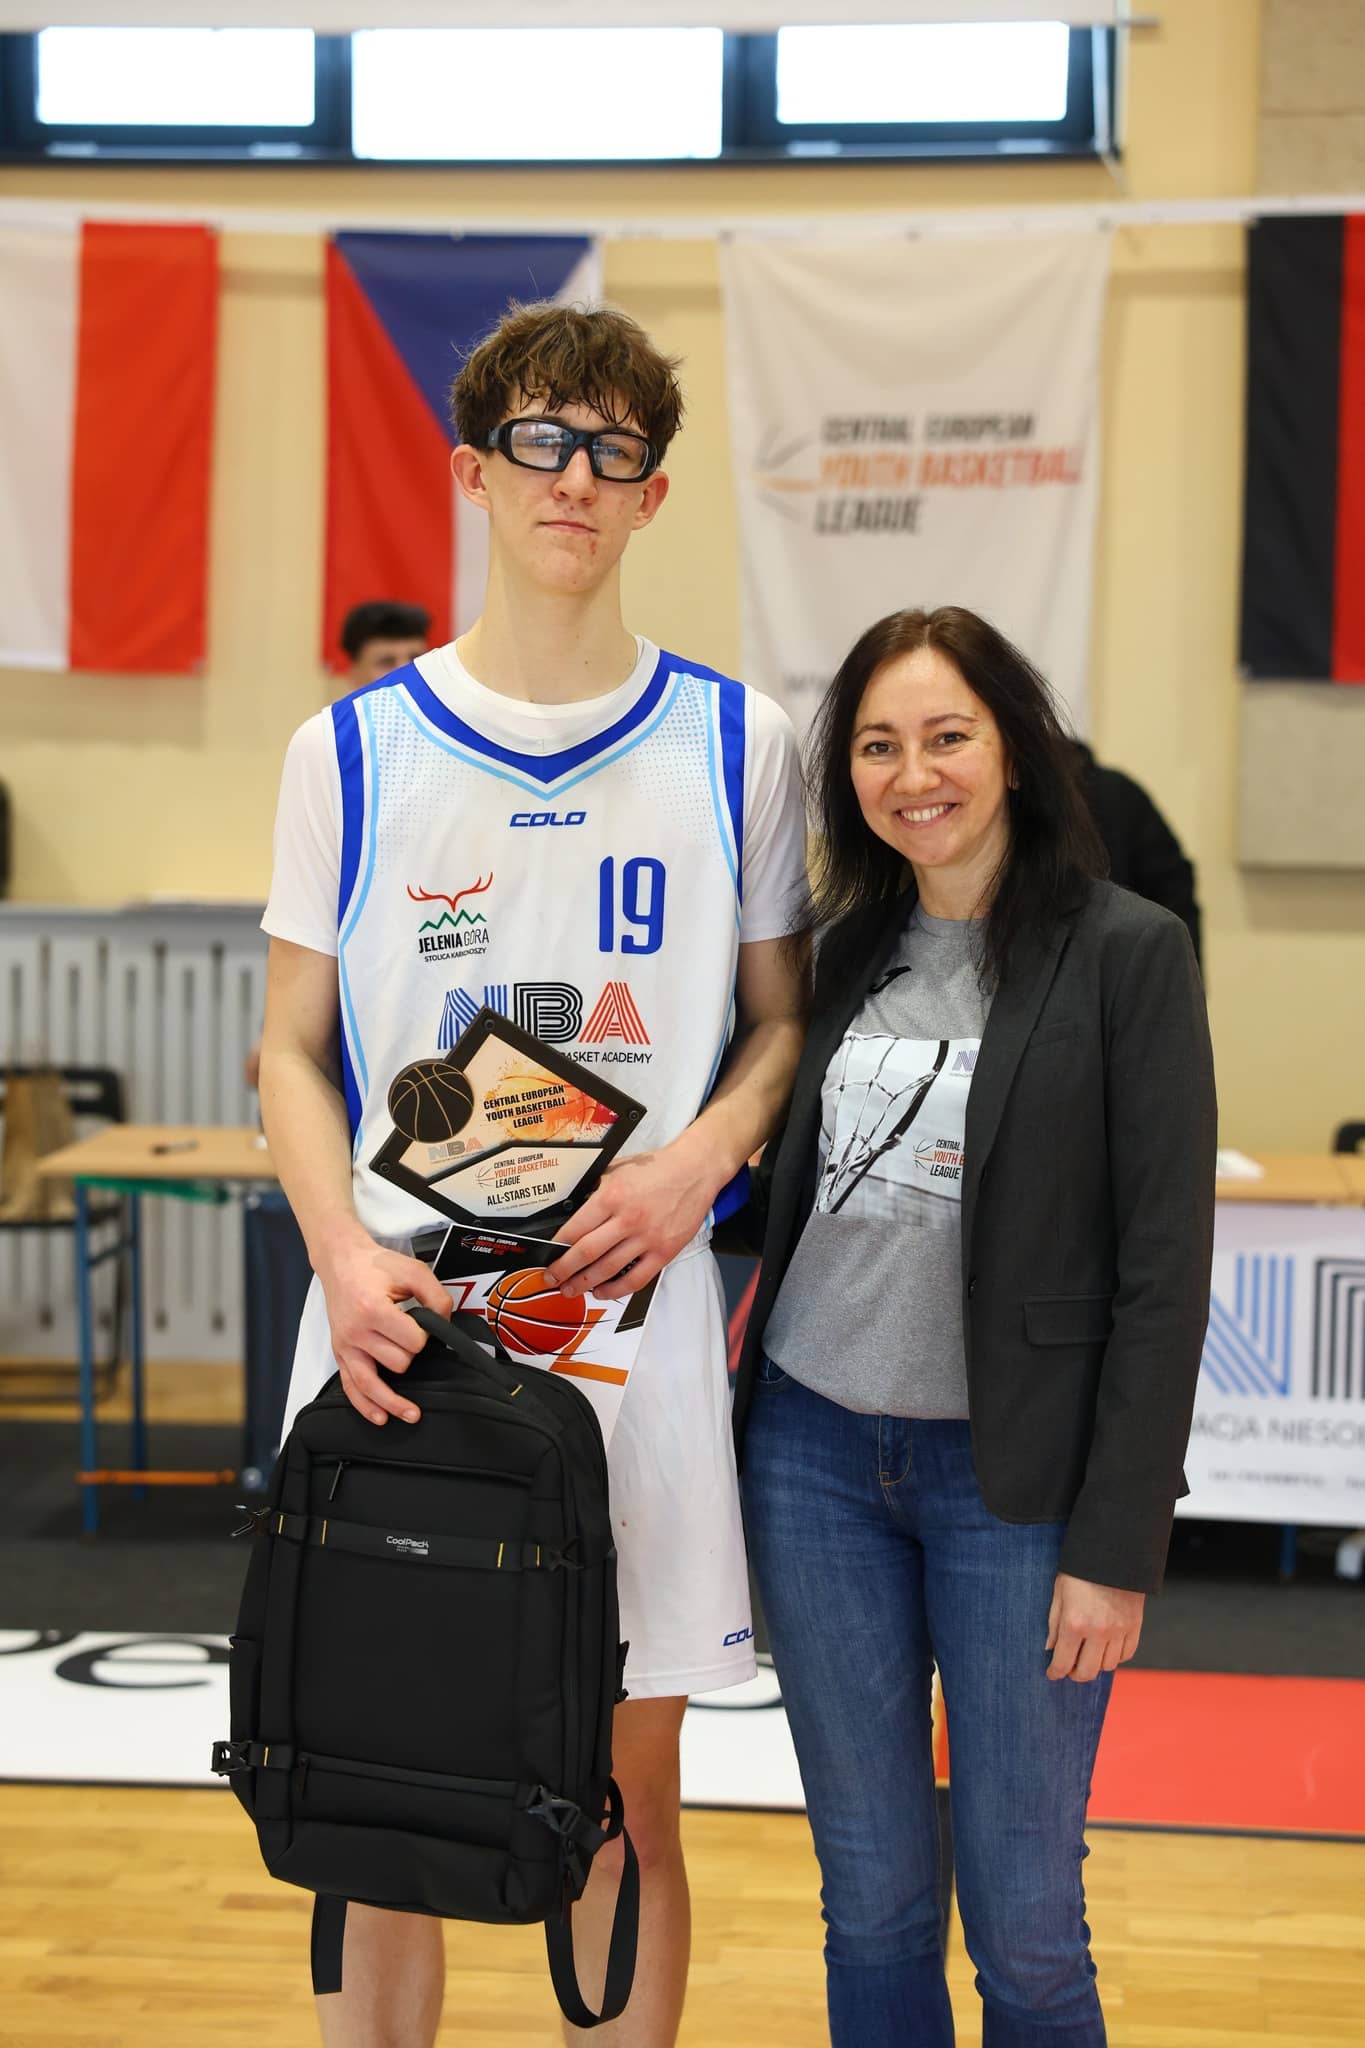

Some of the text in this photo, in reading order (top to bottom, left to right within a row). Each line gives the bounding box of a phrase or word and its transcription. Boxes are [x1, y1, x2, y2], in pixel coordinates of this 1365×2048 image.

[821, 448, 1082, 488] YOUTH BASKETBALL
[815, 496, 921, 535] LEAGUE
[509, 811, 587, 827] COLO
[598, 855, 666, 955] 19
[418, 928, 490, 953] JELENIA GÓRA
[424, 953, 450, 962] STOLICA
[437, 981, 651, 1049] NBA
[602, 1051, 653, 1064] ACADEMY
[483, 1085, 565, 1110] CENTRAL EUROPEAN
[485, 1097, 567, 1122] YOUTH BASKETBALL
[513, 1114, 544, 1128] LEAGUE
[428, 1136, 484, 1160] NBA
[935, 1139, 960, 1151] CENTRAL
[494, 1153, 543, 1169] CENTRAL EUROPEAN
[934, 1150, 958, 1165] YOUTH
[494, 1158, 559, 1178] YOUTH BASKETBALL
[930, 1164, 961, 1180] LEAGUE
[495, 1175, 520, 1188] LEAGUE
[487, 1187, 531, 1206] ALL-STARS
[531, 1182, 556, 1197] TEAM
[386, 1535, 429, 1549] CoolPack
